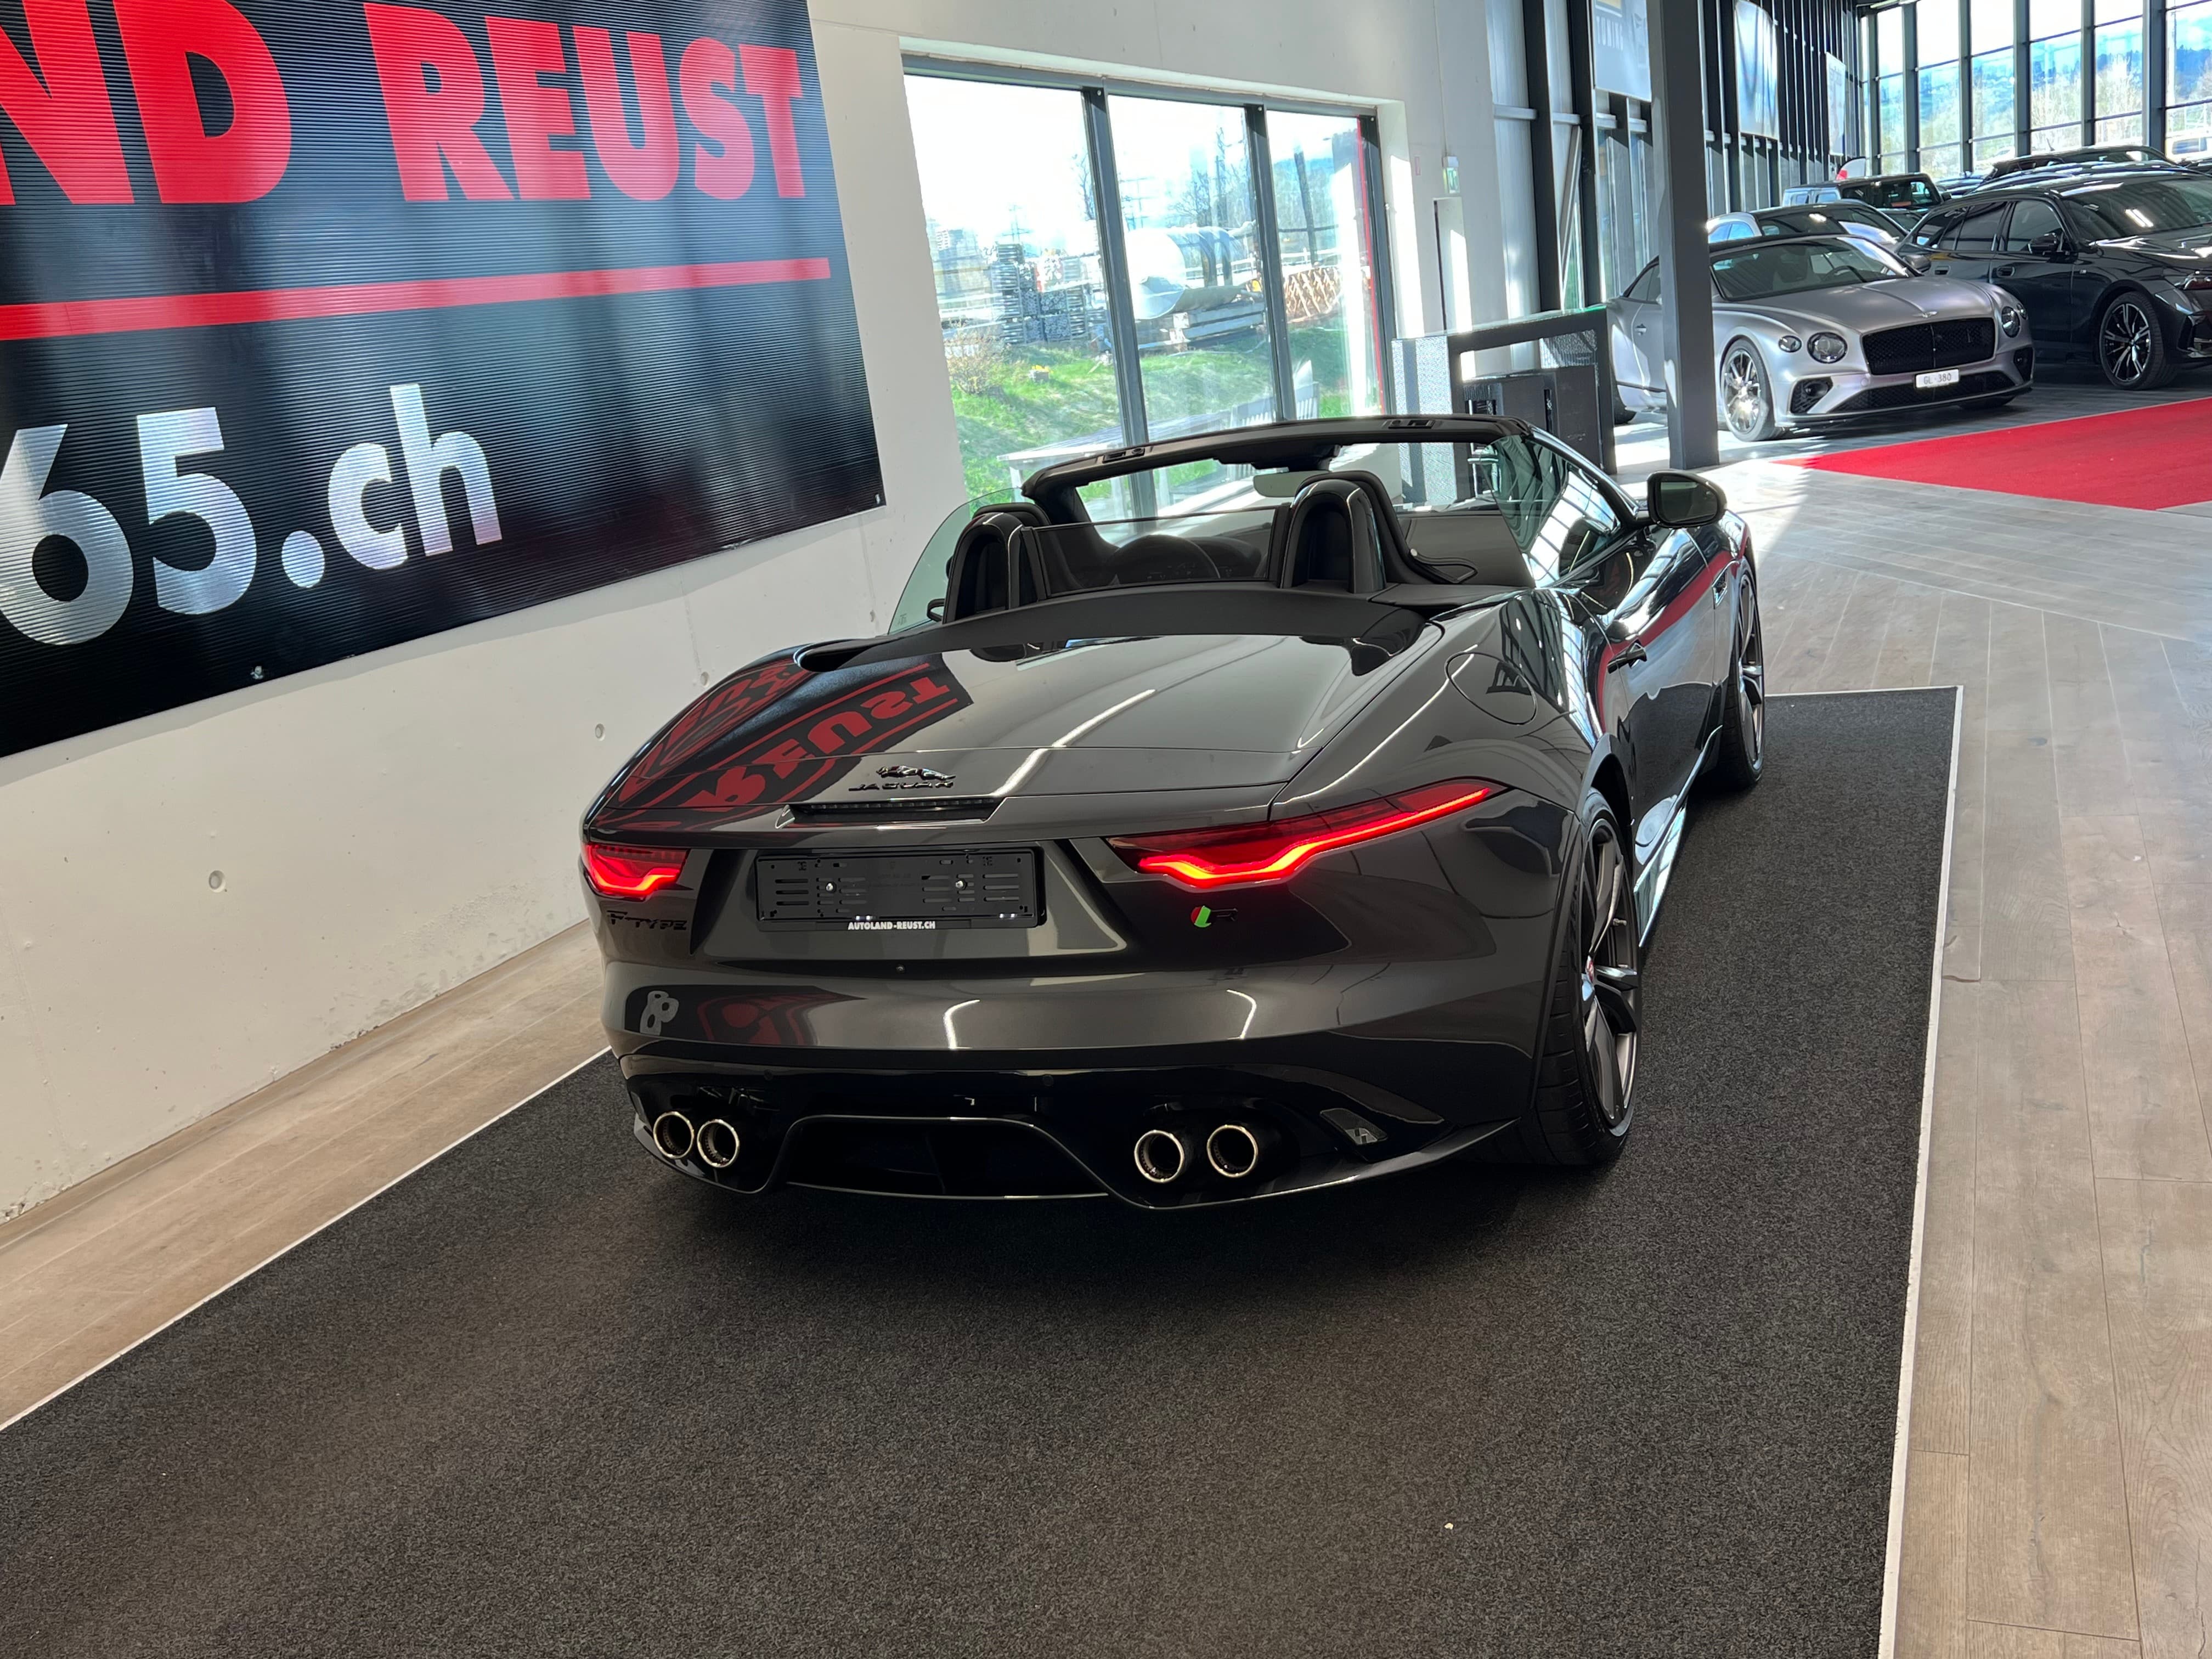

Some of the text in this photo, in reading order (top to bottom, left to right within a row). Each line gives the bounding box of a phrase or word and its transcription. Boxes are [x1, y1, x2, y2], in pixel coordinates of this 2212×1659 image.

[0, 0, 804, 205] ND REUST
[1938, 373, 1951, 382] 380
[0, 383, 503, 645] 65.ch
[848, 781, 954, 791] JAGUAR
[607, 910, 687, 930] F-TYPE
[848, 921, 935, 930] AUTOLAND-REUST.CH
